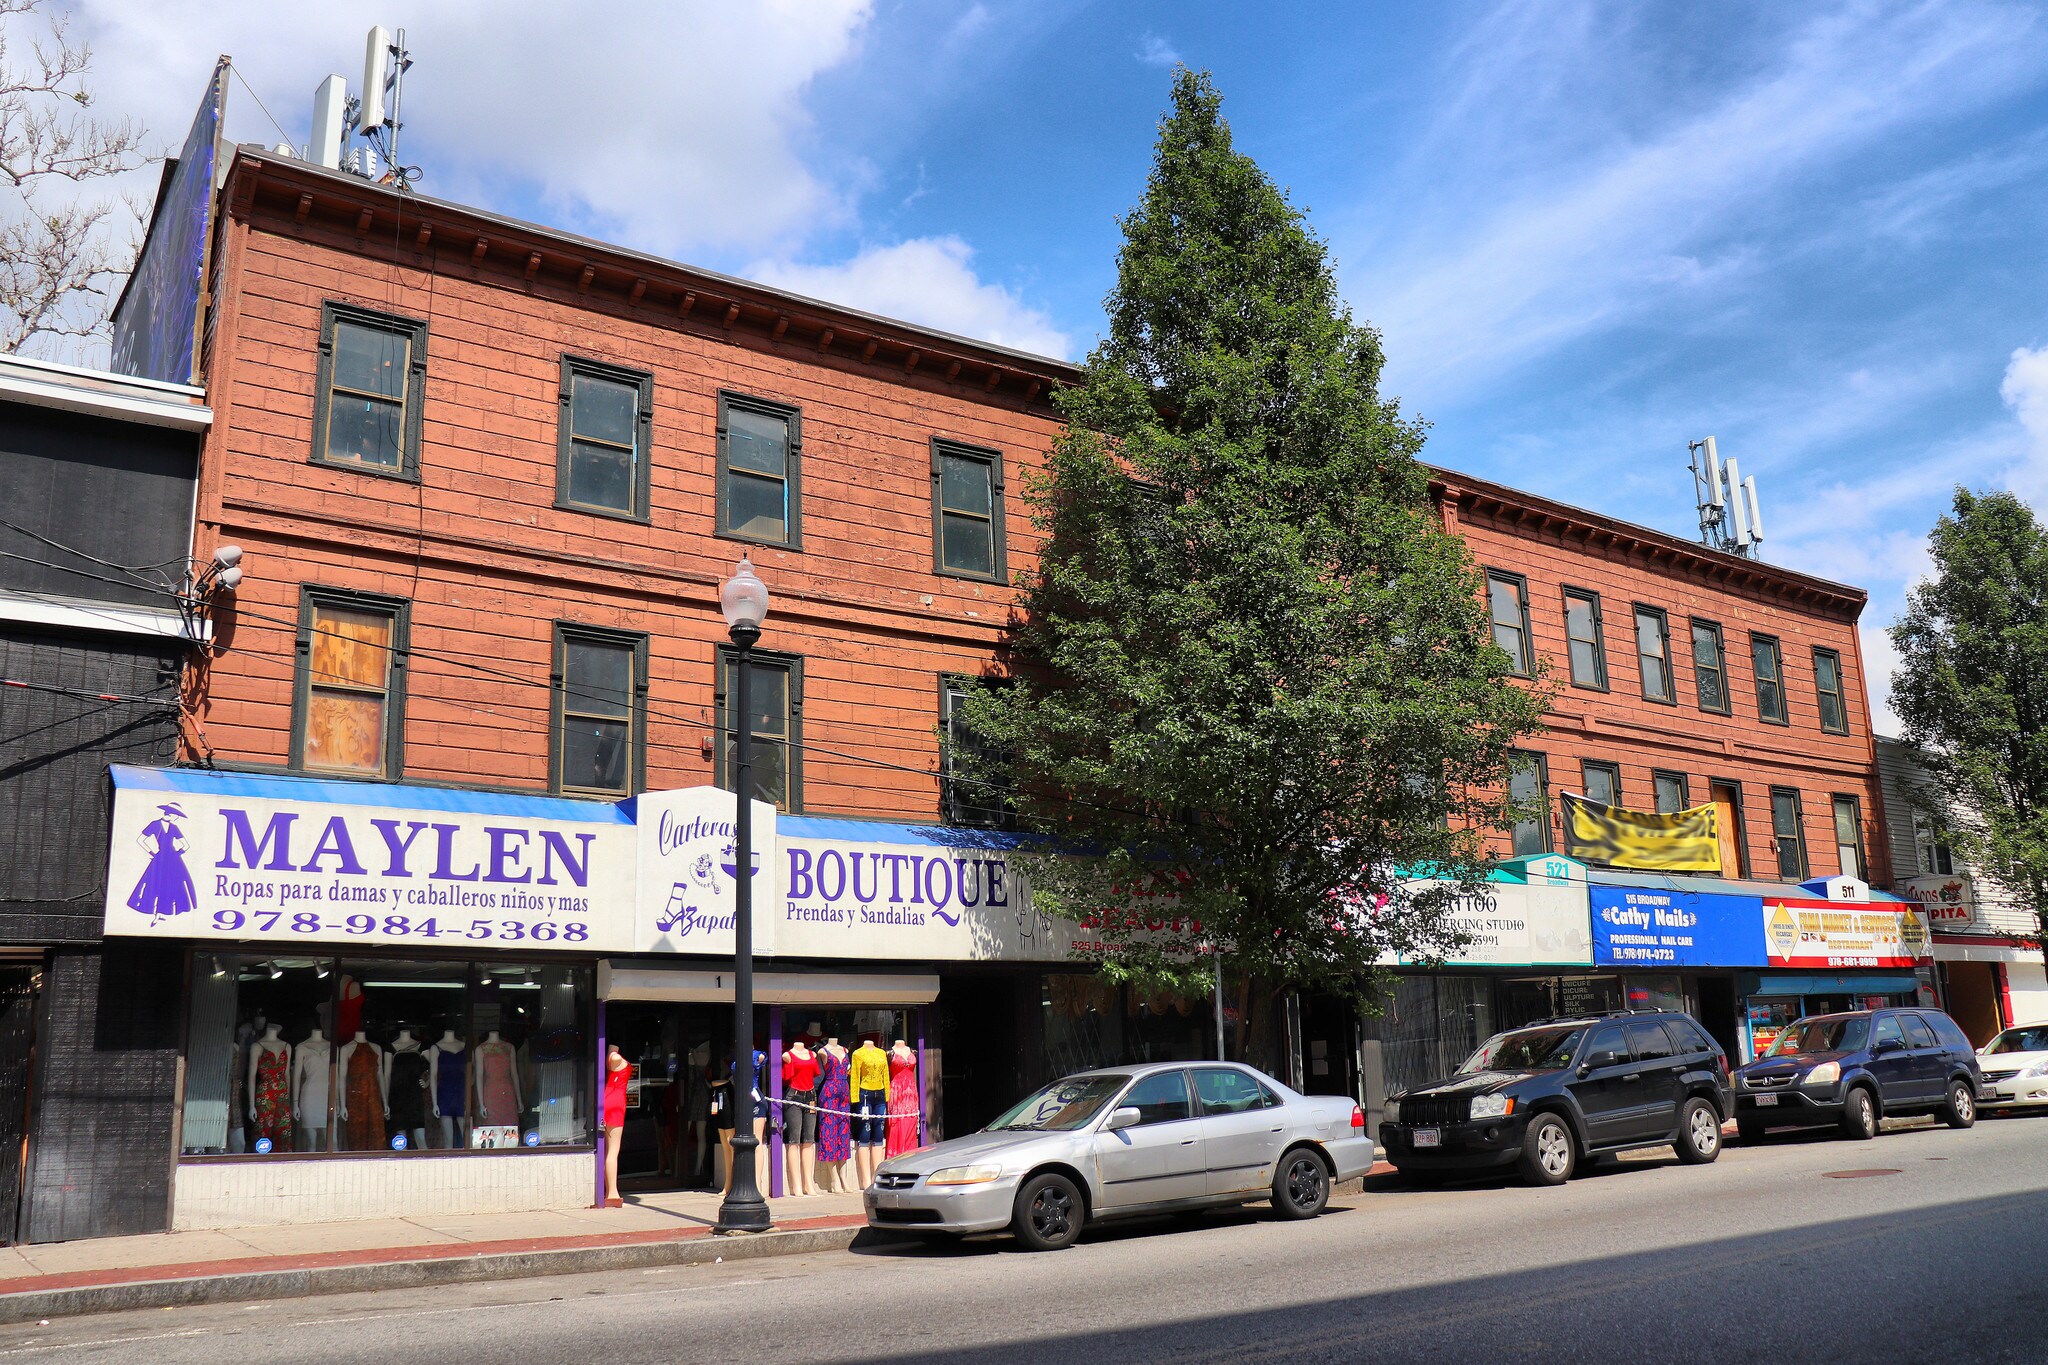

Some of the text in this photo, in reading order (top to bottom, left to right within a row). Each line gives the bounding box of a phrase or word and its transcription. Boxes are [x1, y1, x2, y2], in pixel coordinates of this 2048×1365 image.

[659, 808, 738, 856] Carteras
[215, 808, 596, 887] MAYLEN
[1546, 861, 1569, 878] 521
[214, 874, 588, 917] Ropas para damas y caballeros niños y mas
[786, 848, 1008, 928] BOUTIQUE
[1842, 885, 1855, 898] 511
[1908, 885, 1938, 902] TACOS
[1440, 896, 1497, 912] ATTOO
[1625, 894, 1671, 906] 515 BROADWAY
[681, 906, 738, 937] Zapat
[787, 901, 925, 928] Prendas y Sandalias
[1611, 906, 1689, 930] Cathy Nails
[1929, 907, 1967, 920] PITA
[212, 909, 589, 942] 978-984-5368
[1486, 919, 1525, 931] STUDIO
[1821, 913, 1852, 933] MARKET
[1860, 915, 1897, 934] SERVICES
[1072, 941, 1091, 950] 525
[1094, 941, 1128, 951] Broad
[1610, 934, 1693, 946] PROFESSIONAL NAIL CARE
[1828, 940, 1873, 950] RESTAURANT
[1828, 957, 1878, 967] 978-681-9990
[1554, 987, 1588, 995] PDICURE
[1556, 993, 1595, 1001] ULPTURE
